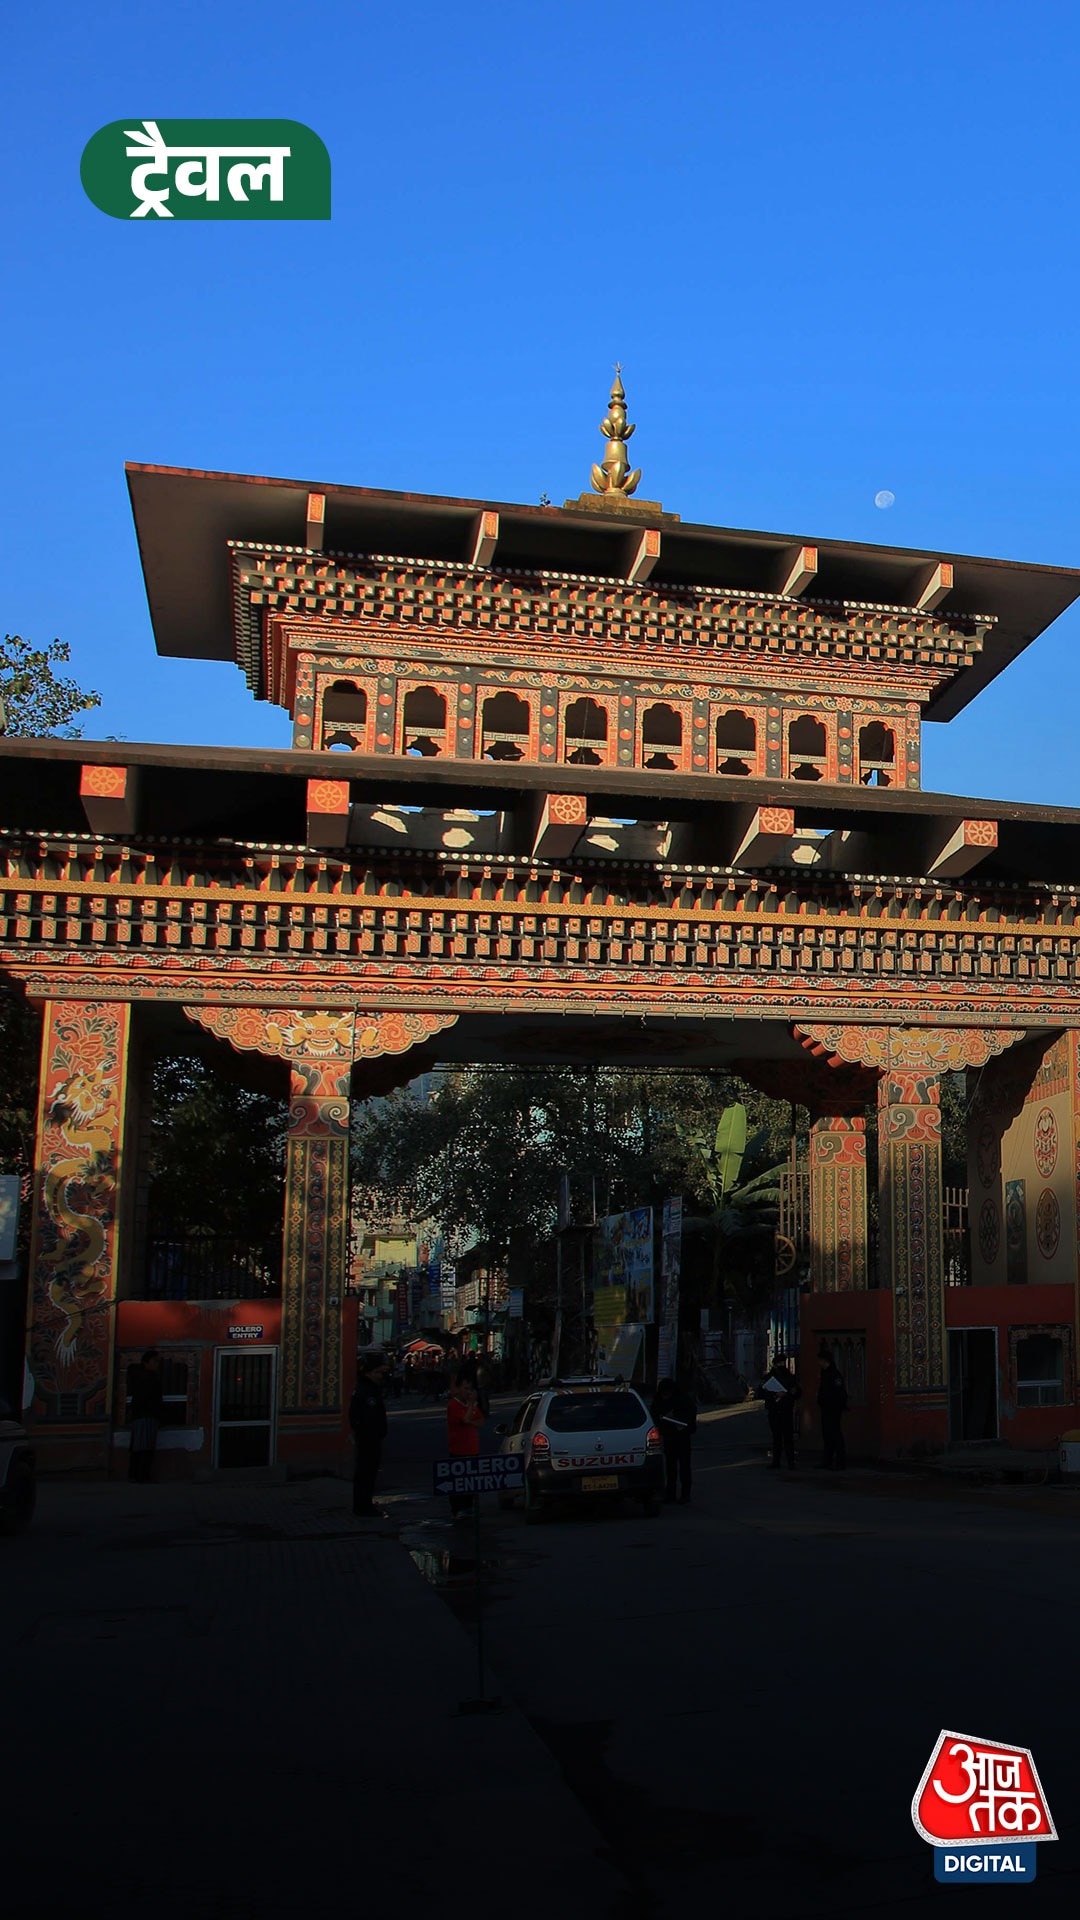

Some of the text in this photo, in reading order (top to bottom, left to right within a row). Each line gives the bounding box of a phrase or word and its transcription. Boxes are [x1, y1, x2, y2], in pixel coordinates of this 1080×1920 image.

[437, 1456, 520, 1477] BOLERO
[558, 1454, 635, 1468] SUZUKI
[455, 1474, 503, 1492] ENTRY
